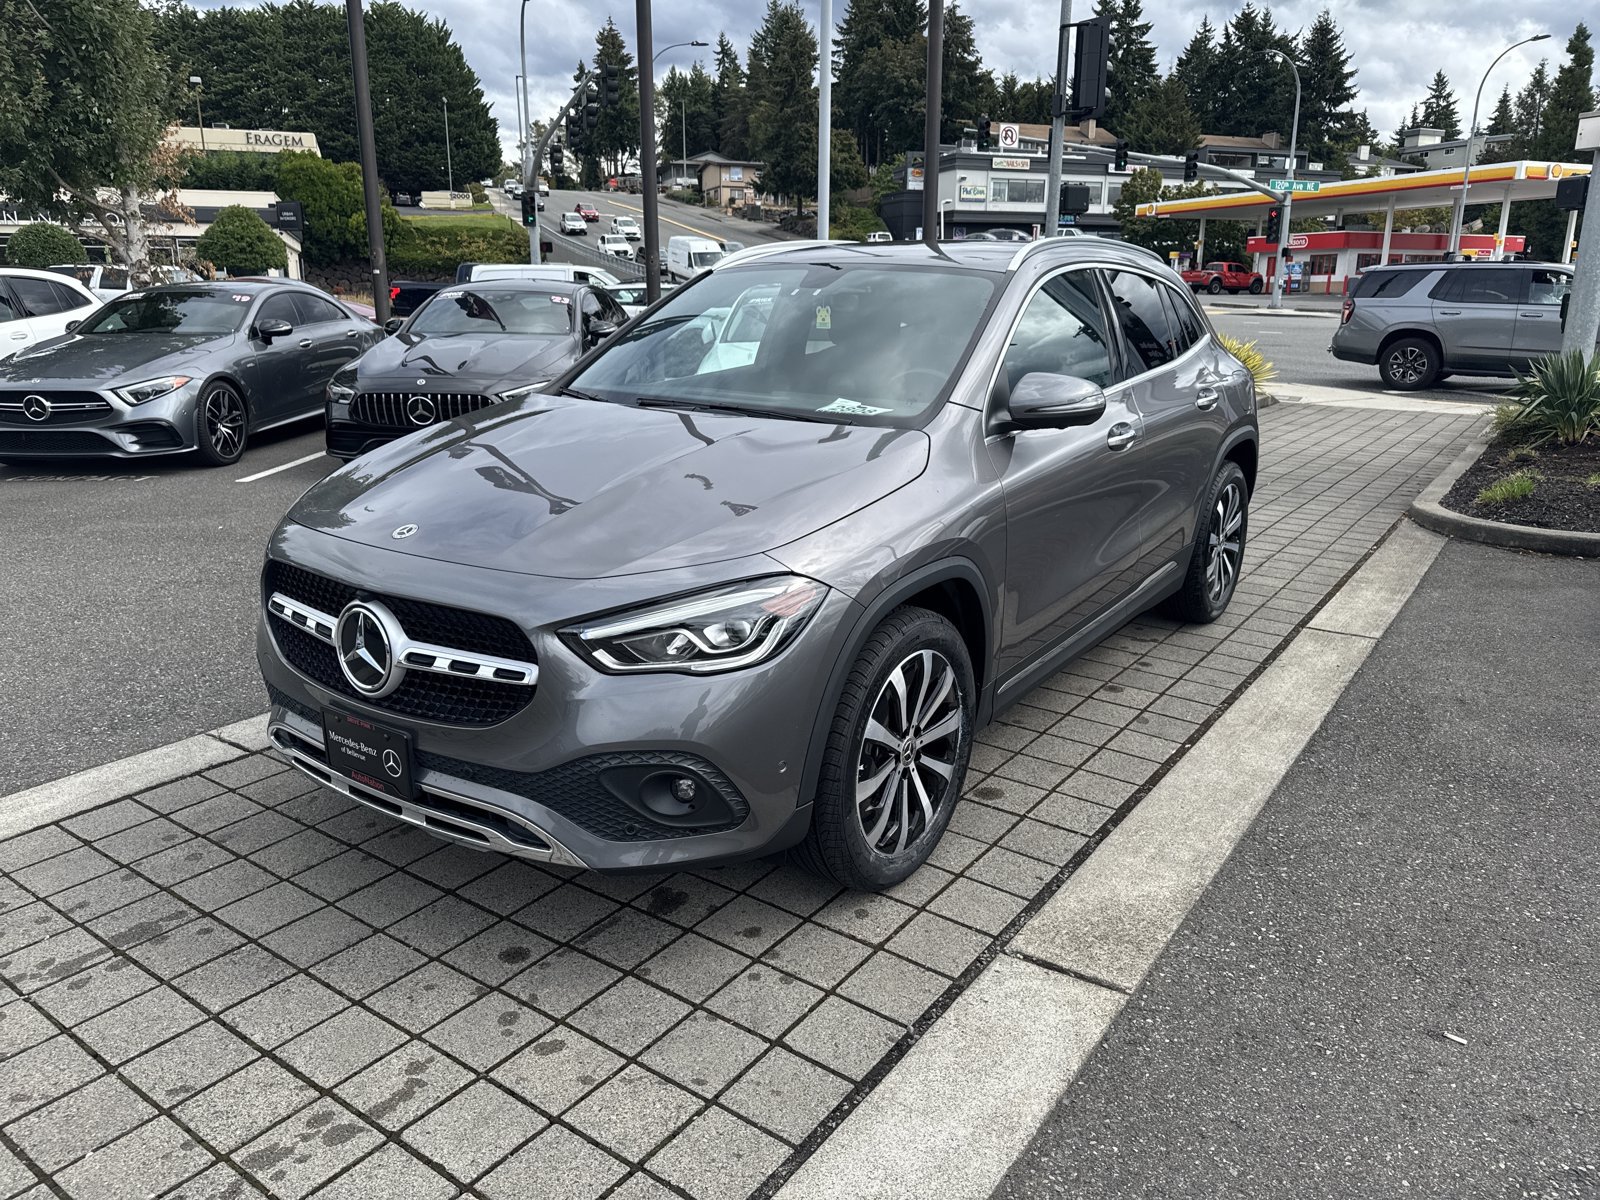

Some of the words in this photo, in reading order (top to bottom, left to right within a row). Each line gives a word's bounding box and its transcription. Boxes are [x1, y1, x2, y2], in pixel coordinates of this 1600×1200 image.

[1275, 181, 1289, 190] 120th
[1292, 182, 1303, 191] Ave
[1306, 182, 1315, 191] NE
[329, 730, 377, 757] Mercedes-Benz
[346, 747, 366, 761] Bellevue
[351, 770, 385, 791] AutoNation
